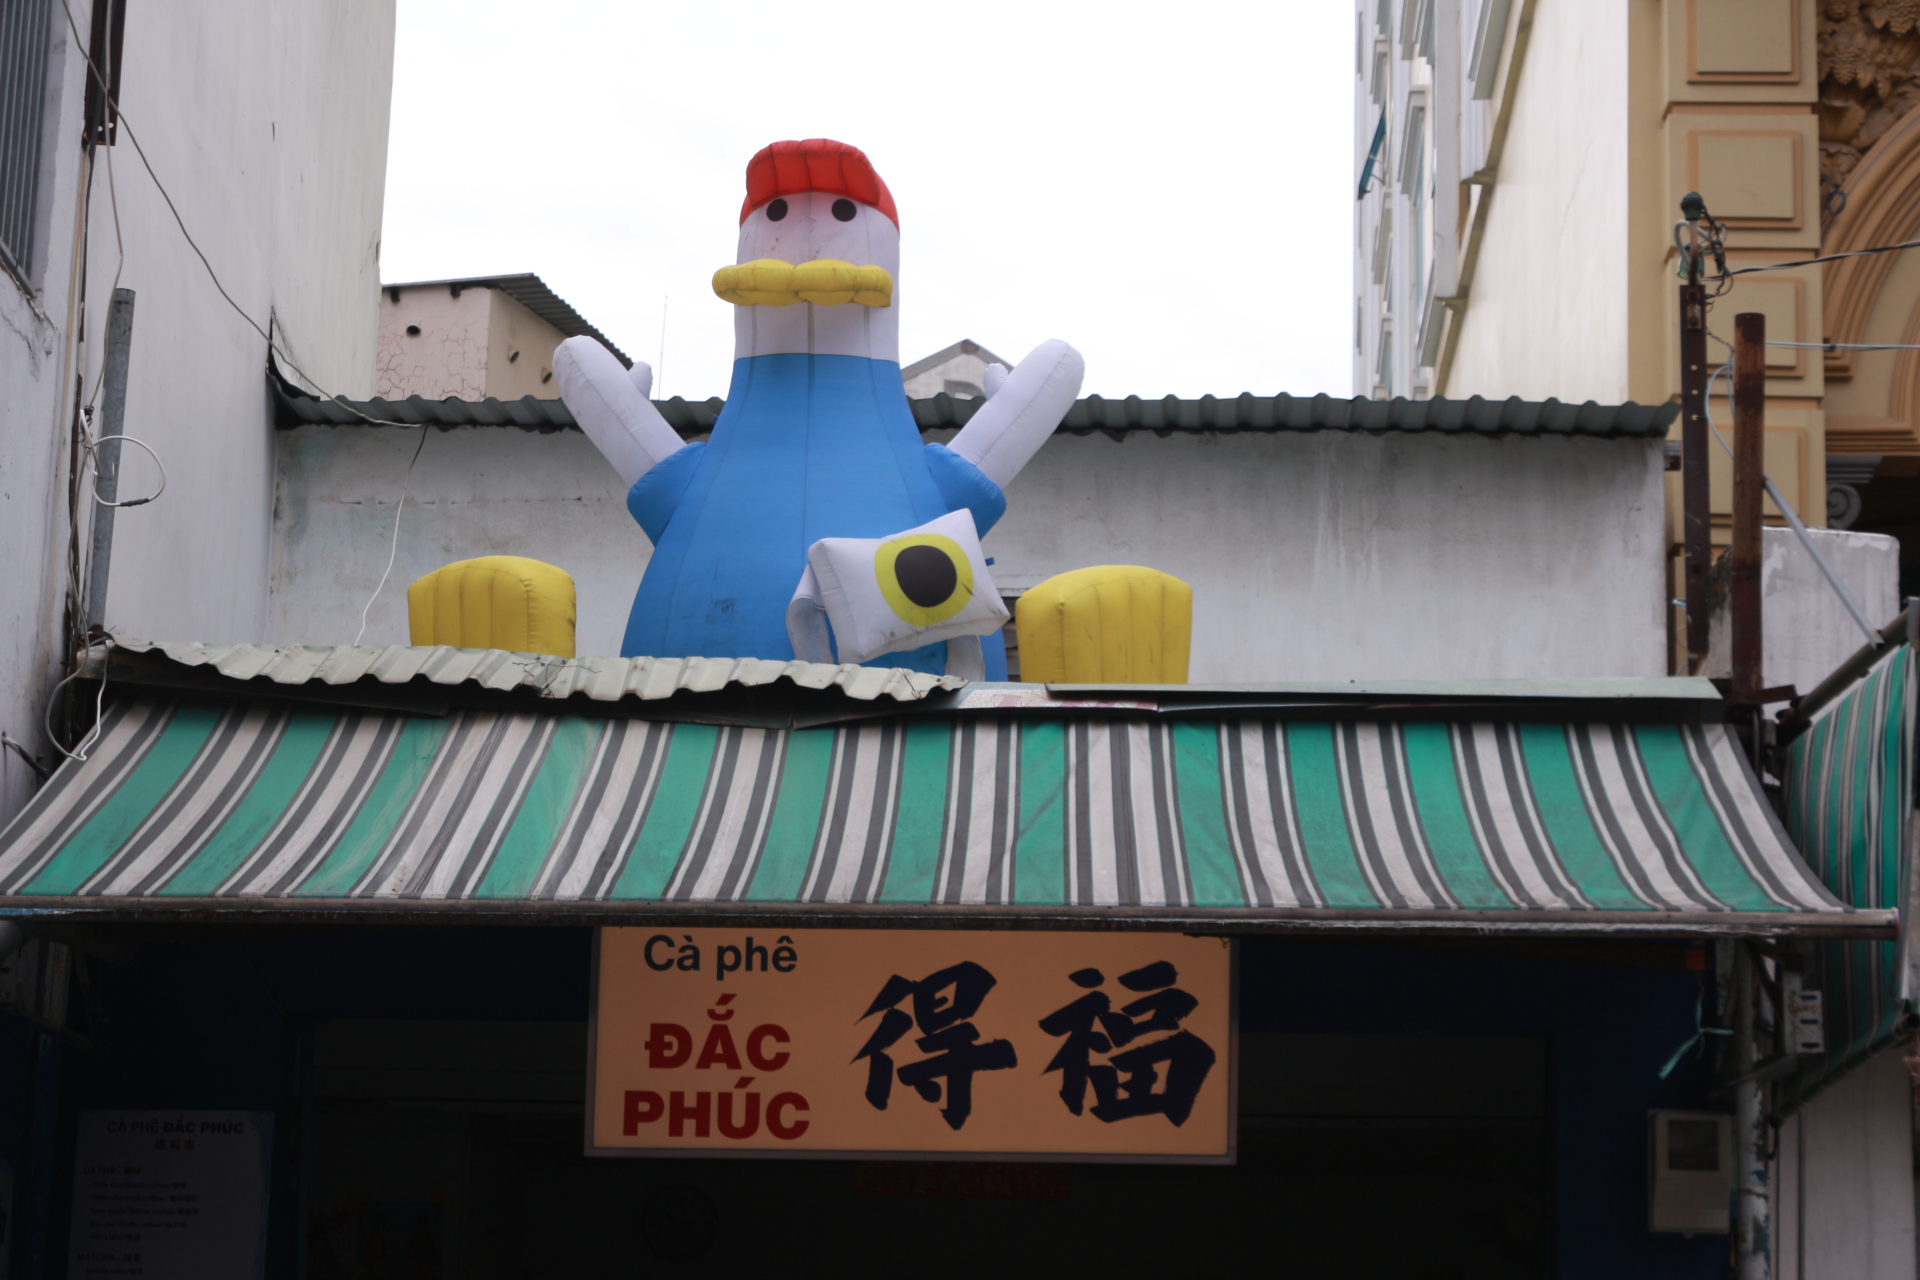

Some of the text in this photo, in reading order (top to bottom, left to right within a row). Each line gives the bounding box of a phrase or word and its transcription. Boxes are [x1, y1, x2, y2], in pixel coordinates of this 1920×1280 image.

[643, 934, 799, 981] Cà phê
[644, 993, 792, 1073] ĐẮC
[849, 960, 1217, 1131] 得福
[200, 1118, 244, 1135] PHÚC
[622, 1076, 812, 1142] PHÚC
